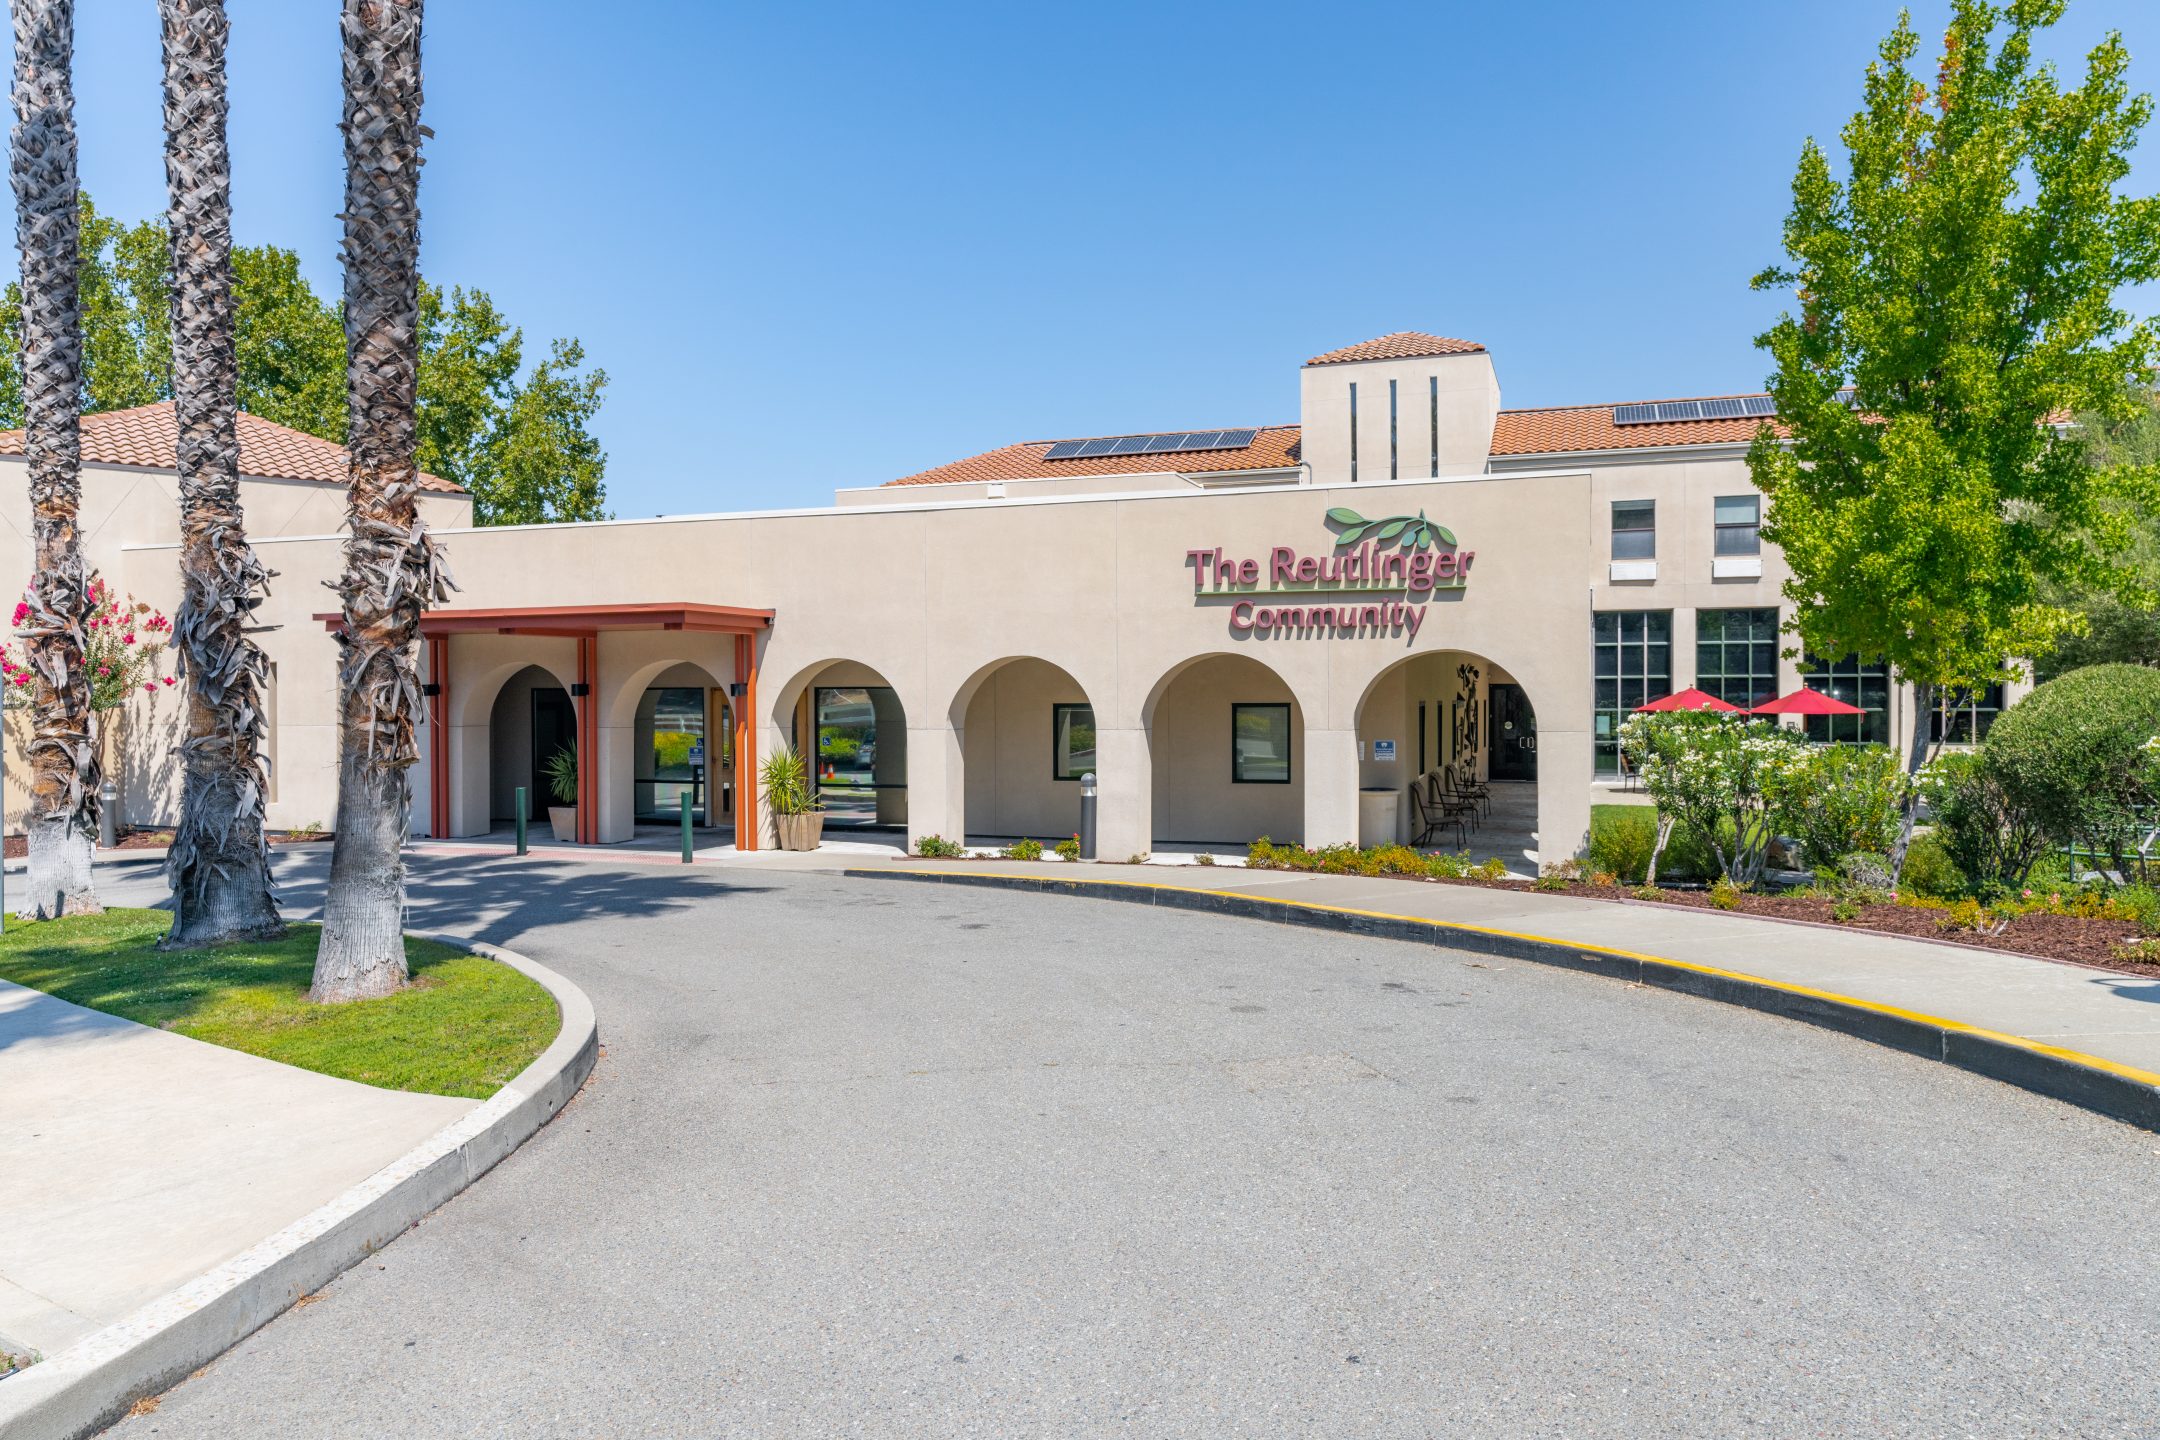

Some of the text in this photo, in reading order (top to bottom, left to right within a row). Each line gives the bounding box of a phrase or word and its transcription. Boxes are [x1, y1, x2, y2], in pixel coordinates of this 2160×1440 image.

[1186, 541, 1476, 591] The Reutlinger
[1231, 597, 1427, 636] Community
